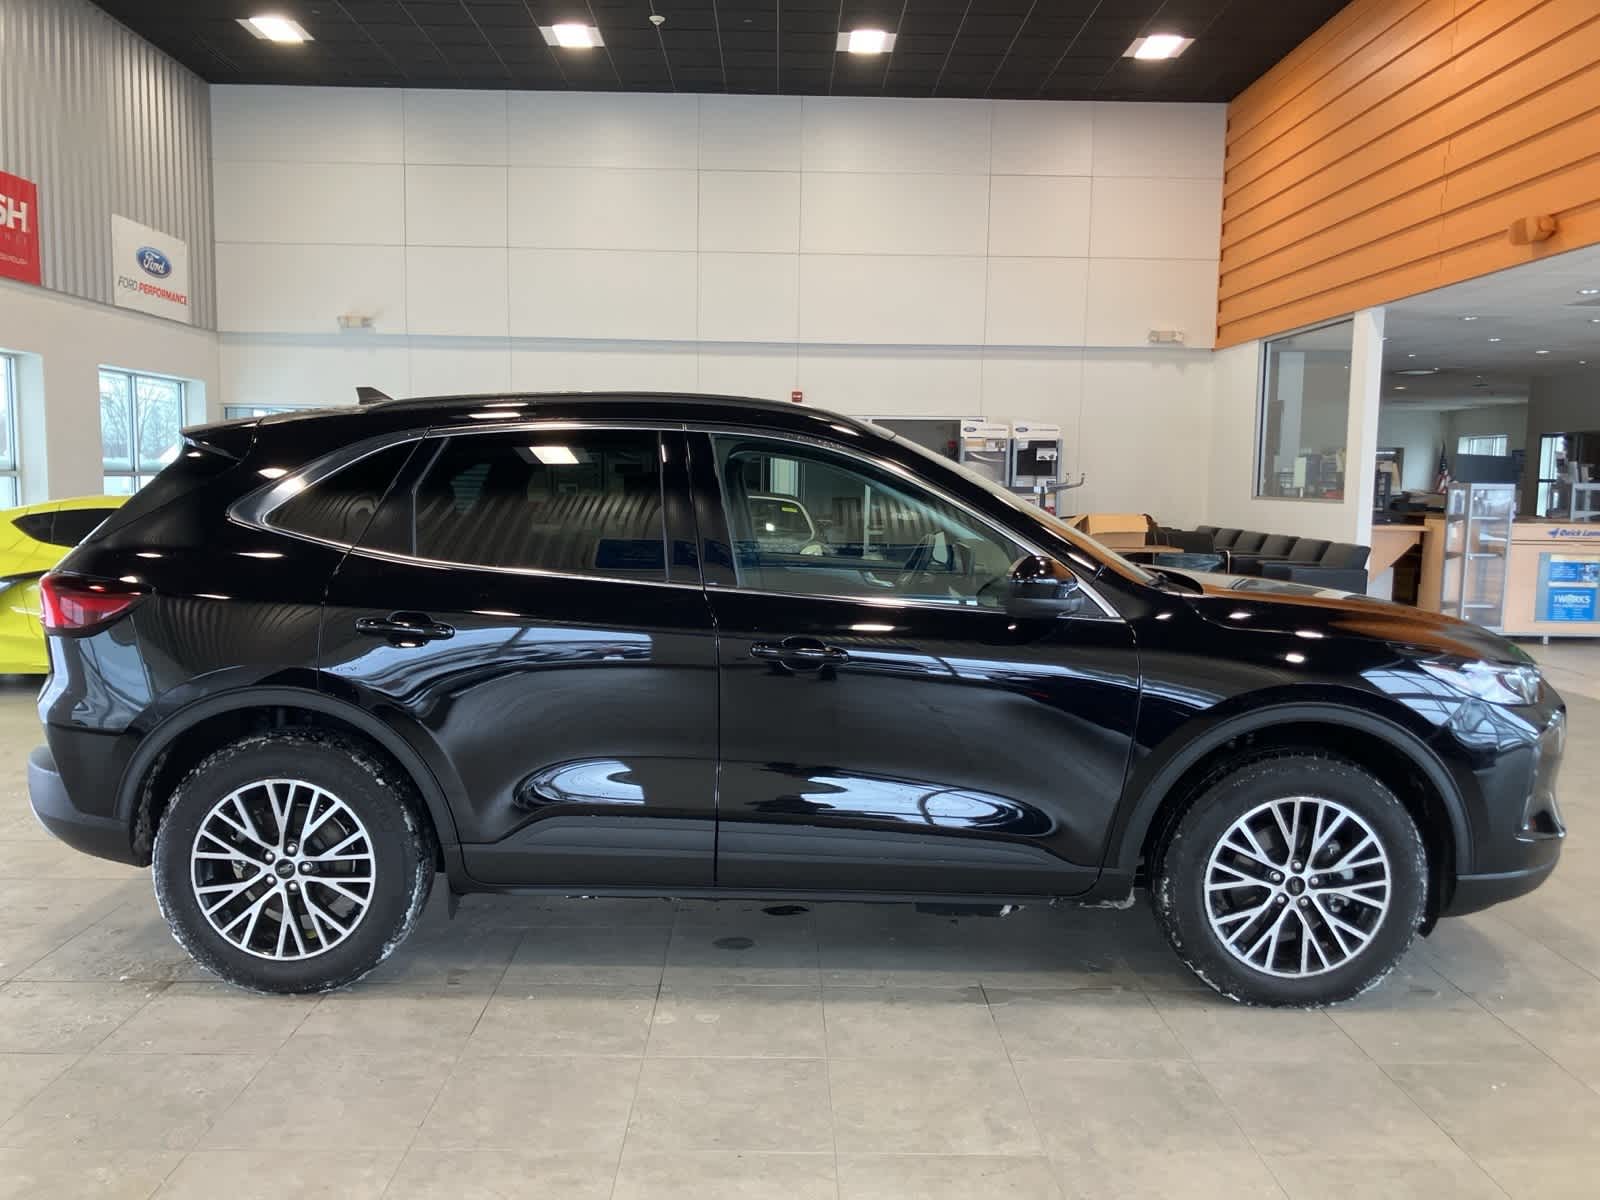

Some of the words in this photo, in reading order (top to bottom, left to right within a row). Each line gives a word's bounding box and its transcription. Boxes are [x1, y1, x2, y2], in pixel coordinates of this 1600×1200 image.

[142, 250, 166, 274] Ford
[118, 275, 138, 291] FORD
[138, 281, 187, 306] PERFORMANCE
